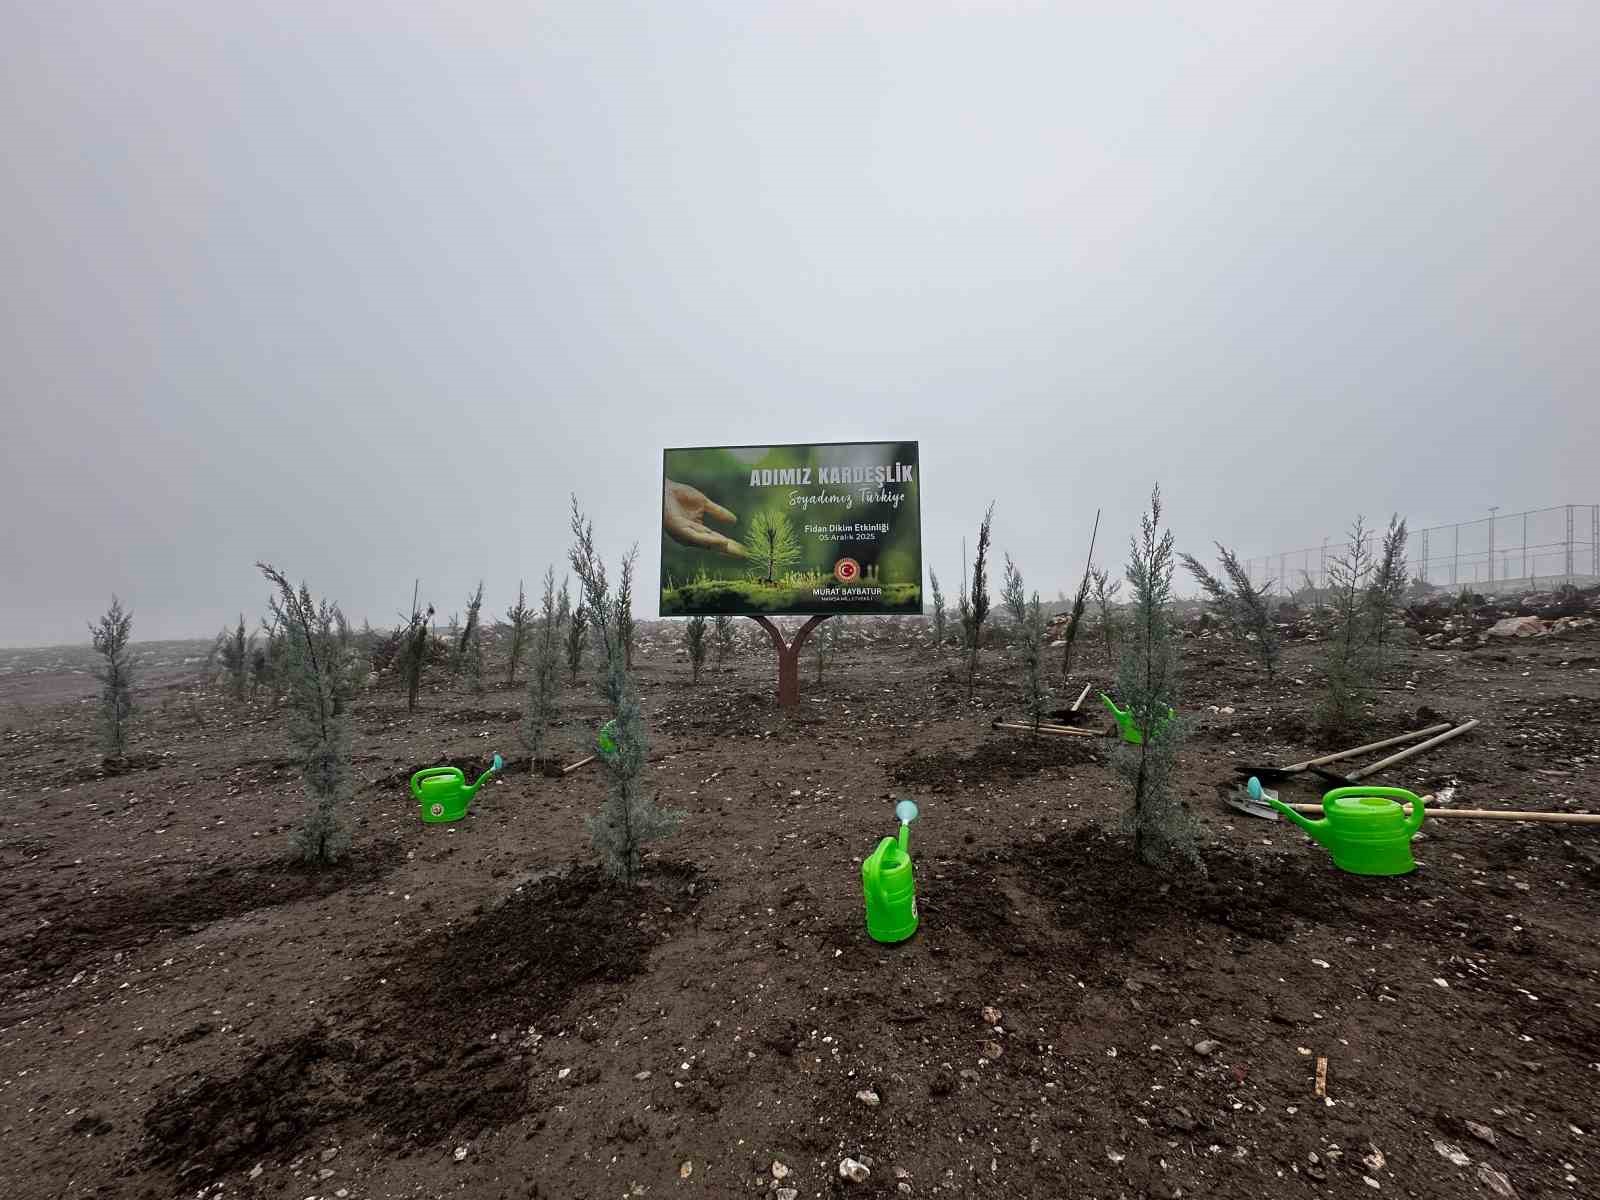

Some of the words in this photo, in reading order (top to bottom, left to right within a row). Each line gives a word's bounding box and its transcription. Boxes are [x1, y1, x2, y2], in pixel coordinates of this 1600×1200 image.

[750, 467, 812, 486] ADIMIZ
[818, 462, 913, 487] KARDEŞLİK
[858, 487, 905, 508] Türkiye
[804, 525, 827, 533] Fidan
[829, 524, 853, 532] Dikim
[854, 523, 889, 533] Etkinliği
[812, 588, 840, 596] MURAT
[841, 587, 882, 596] BAYBATUR
